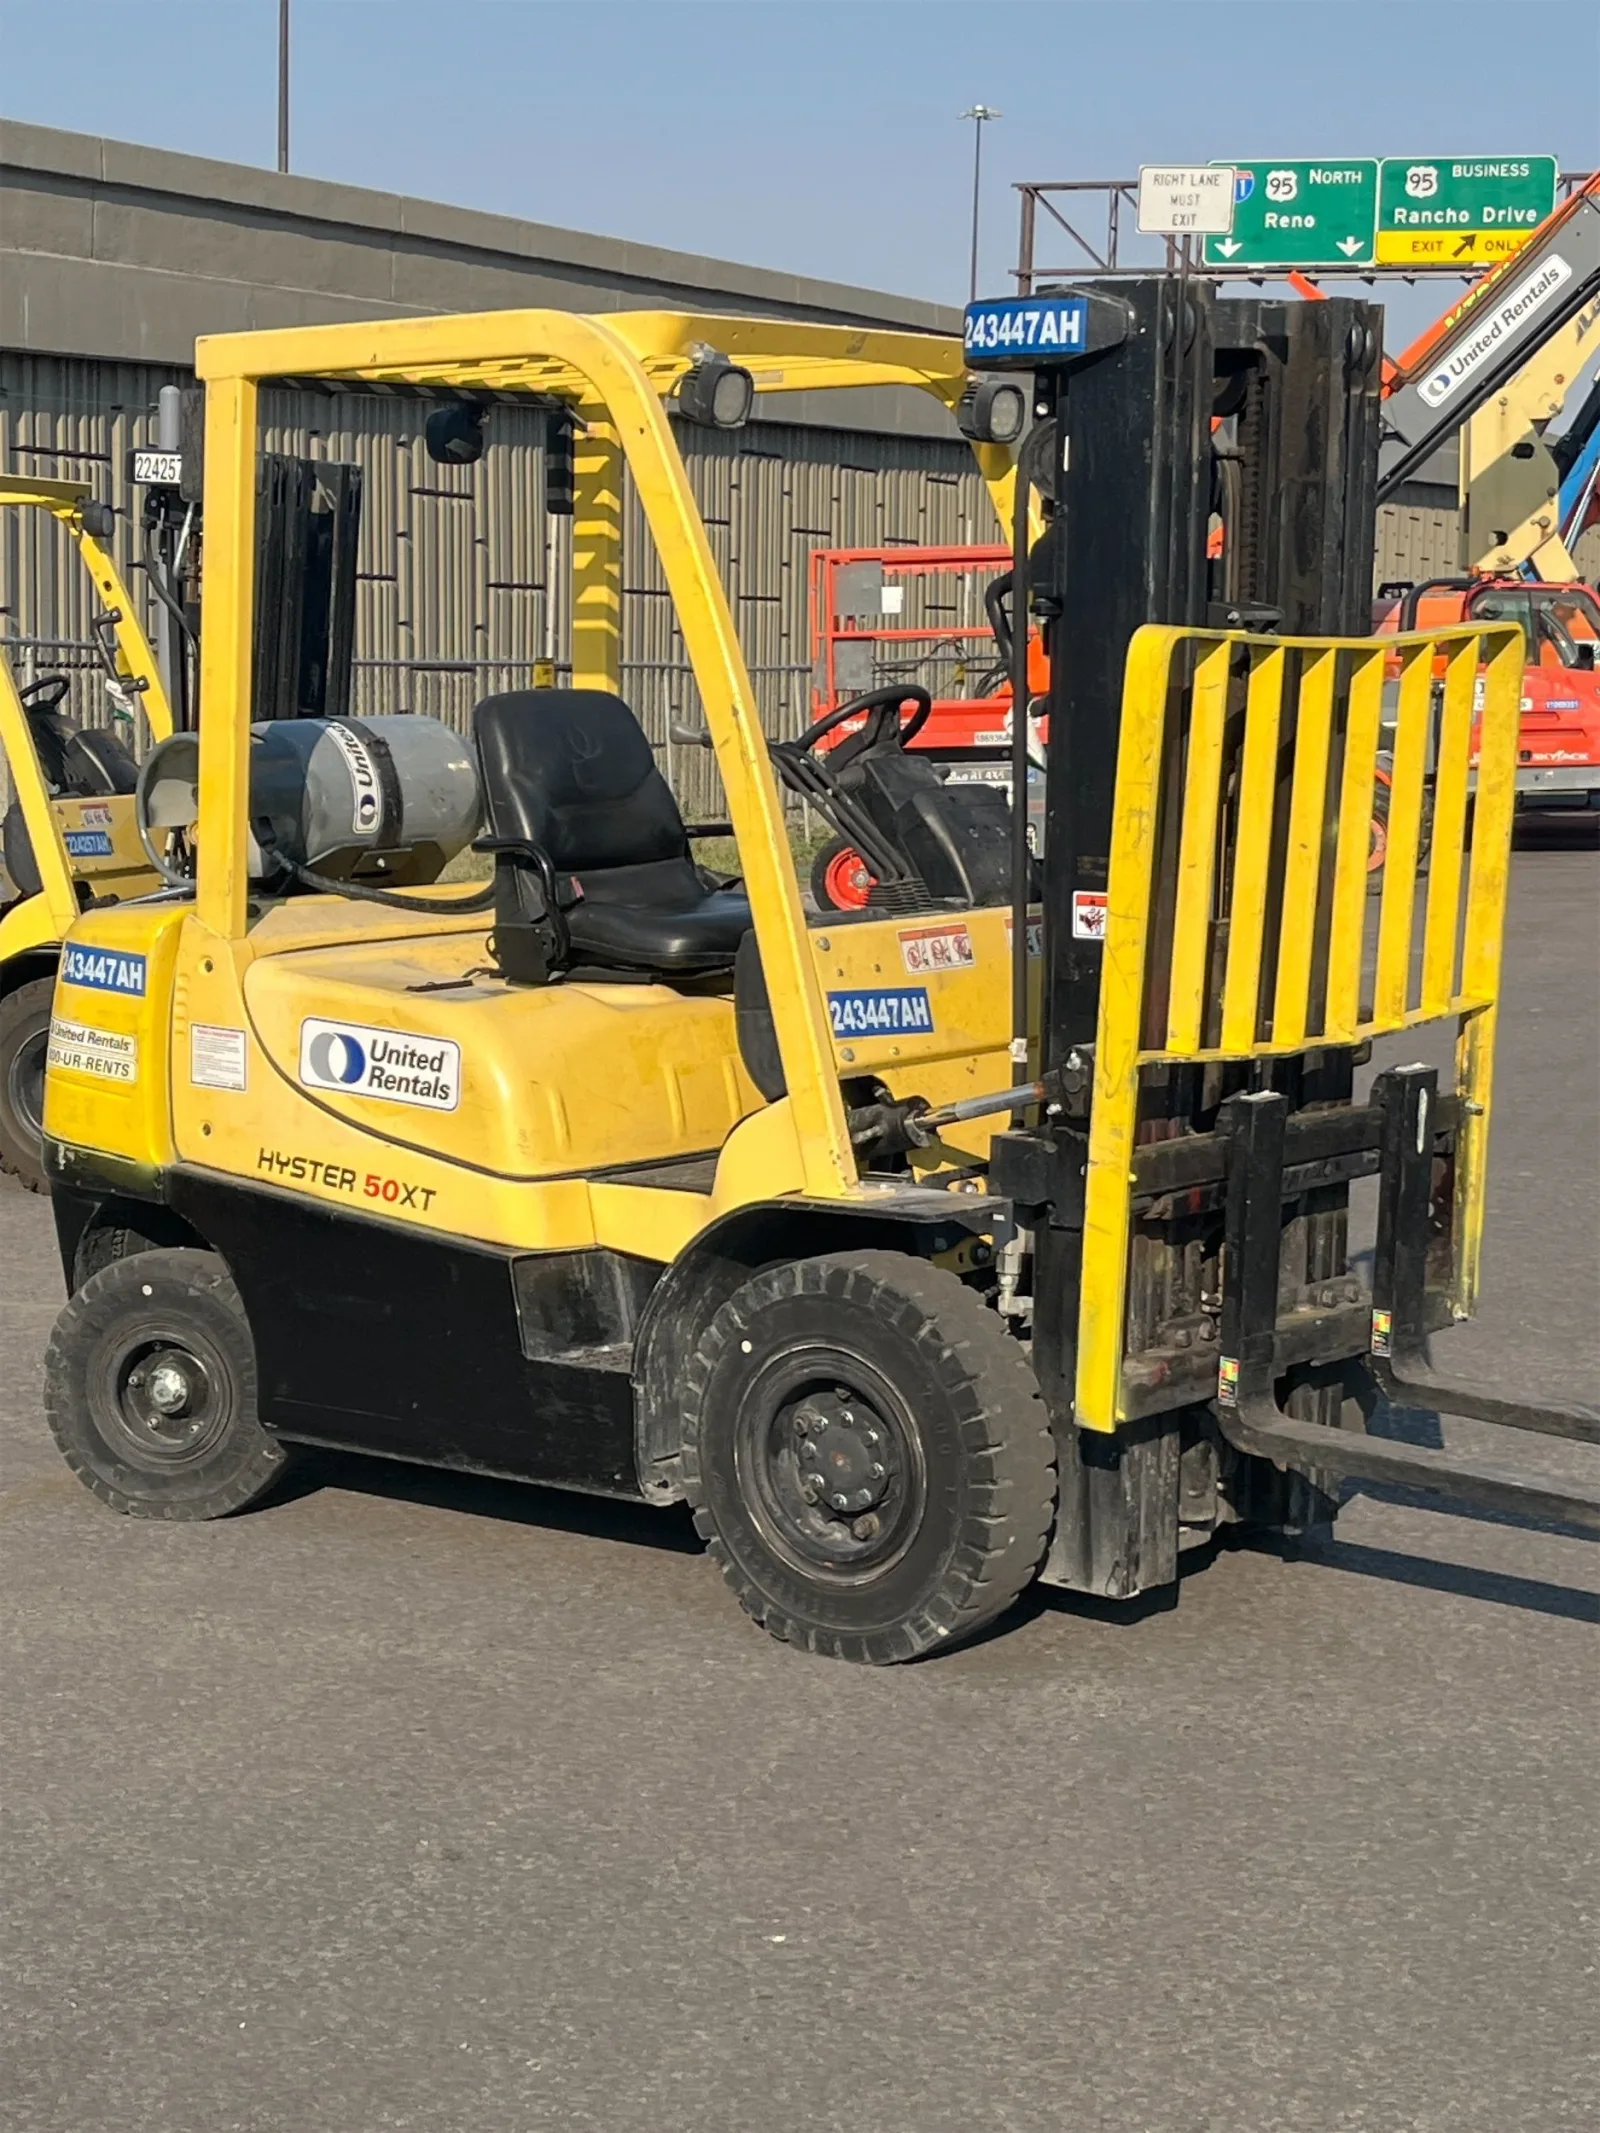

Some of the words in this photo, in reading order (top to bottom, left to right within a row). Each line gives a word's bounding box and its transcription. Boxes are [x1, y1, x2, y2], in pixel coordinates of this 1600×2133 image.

[1153, 173, 1186, 187] RIGHT
[1191, 172, 1221, 187] LANE
[1309, 168, 1362, 184] NORTH
[1451, 163, 1530, 178] BUSINESS
[1270, 177, 1293, 196] 95
[1409, 173, 1434, 191] 95
[1170, 194, 1200, 206] MUST
[1171, 214, 1198, 227] EXIT
[1265, 212, 1315, 229] Reno
[1394, 207, 1470, 224] Rancho
[1482, 206, 1537, 223] Drive
[1411, 240, 1444, 253] EXIT
[964, 310, 1080, 349] 243447AH
[1449, 320, 1504, 377] United
[1500, 267, 1561, 327] Rentals
[829, 995, 931, 1033] 243447AH
[87, 1031, 131, 1052] Rentals
[370, 1038, 446, 1073] United
[367, 1065, 451, 1101] Rentals
[257, 1147, 358, 1193] HYSTER
[363, 1173, 437, 1211] 50XT
